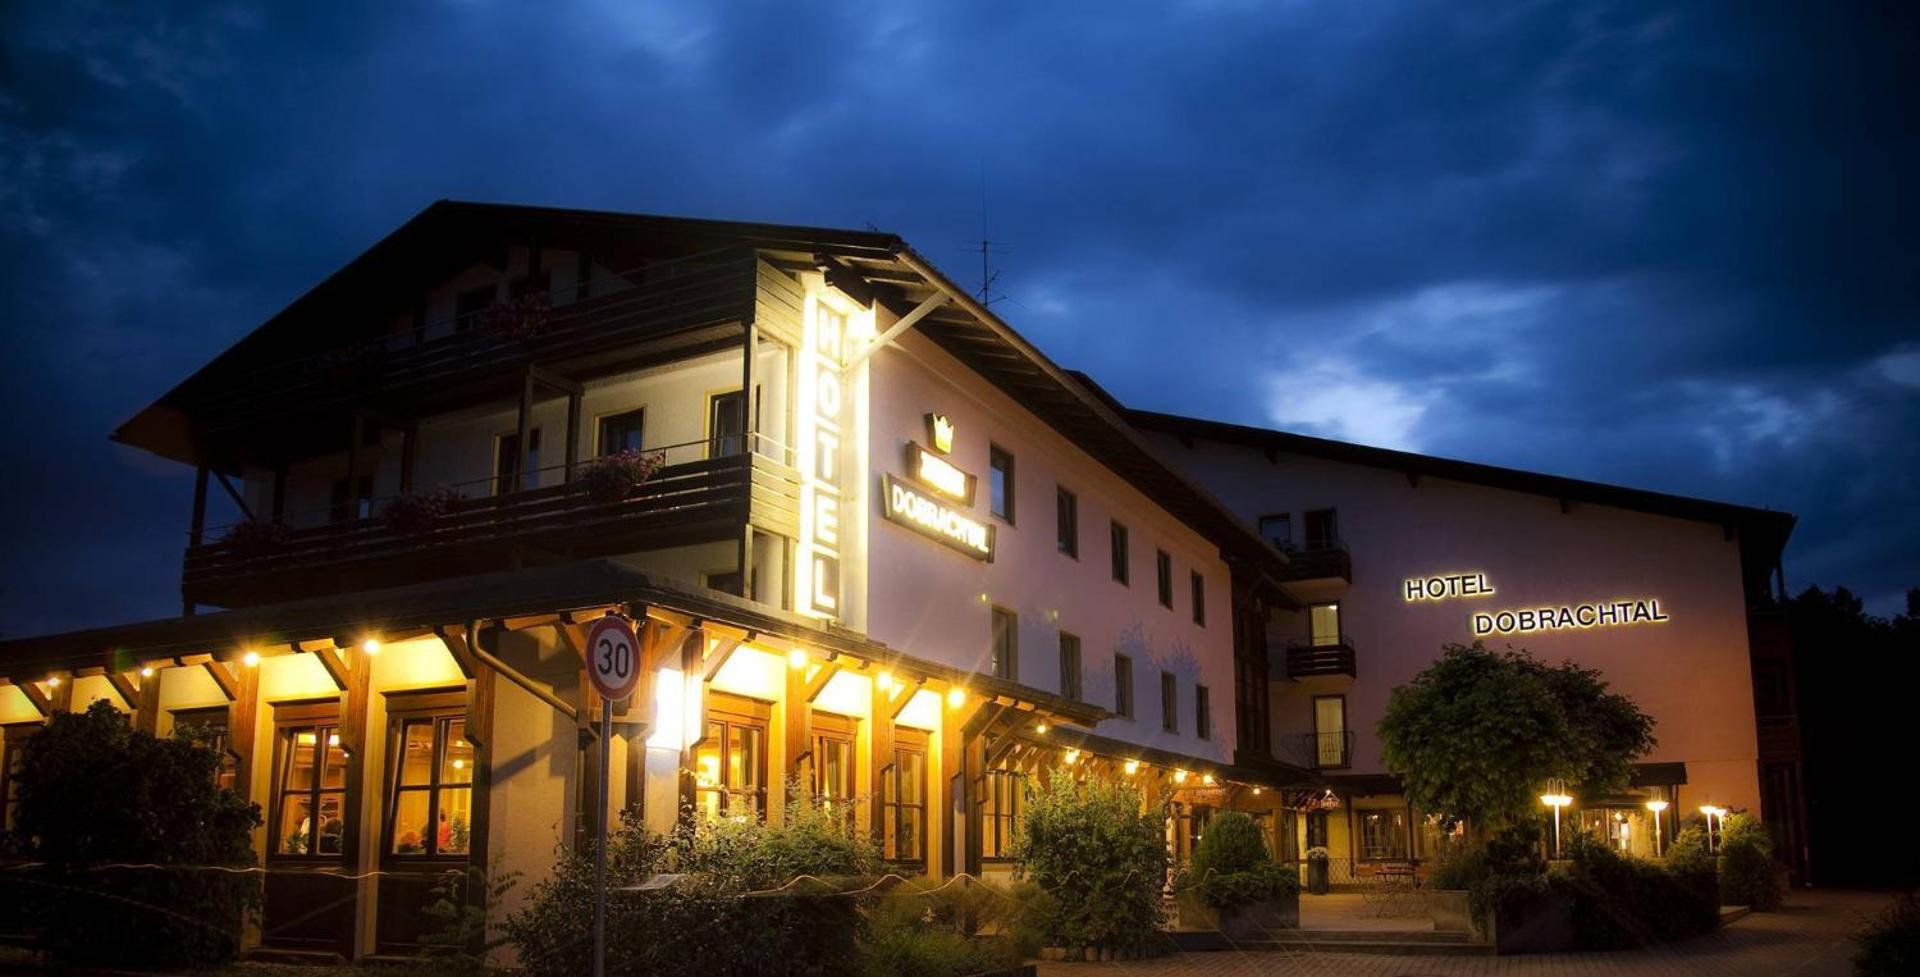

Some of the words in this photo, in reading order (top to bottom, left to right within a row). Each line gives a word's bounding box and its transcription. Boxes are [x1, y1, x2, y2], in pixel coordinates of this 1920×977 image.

[816, 306, 841, 609] HOTEL
[891, 483, 989, 553] DOBRACHTAL
[1406, 573, 1493, 599] HOTEL
[1475, 600, 1668, 634] DOBRACHTAL
[597, 638, 630, 679] 30
